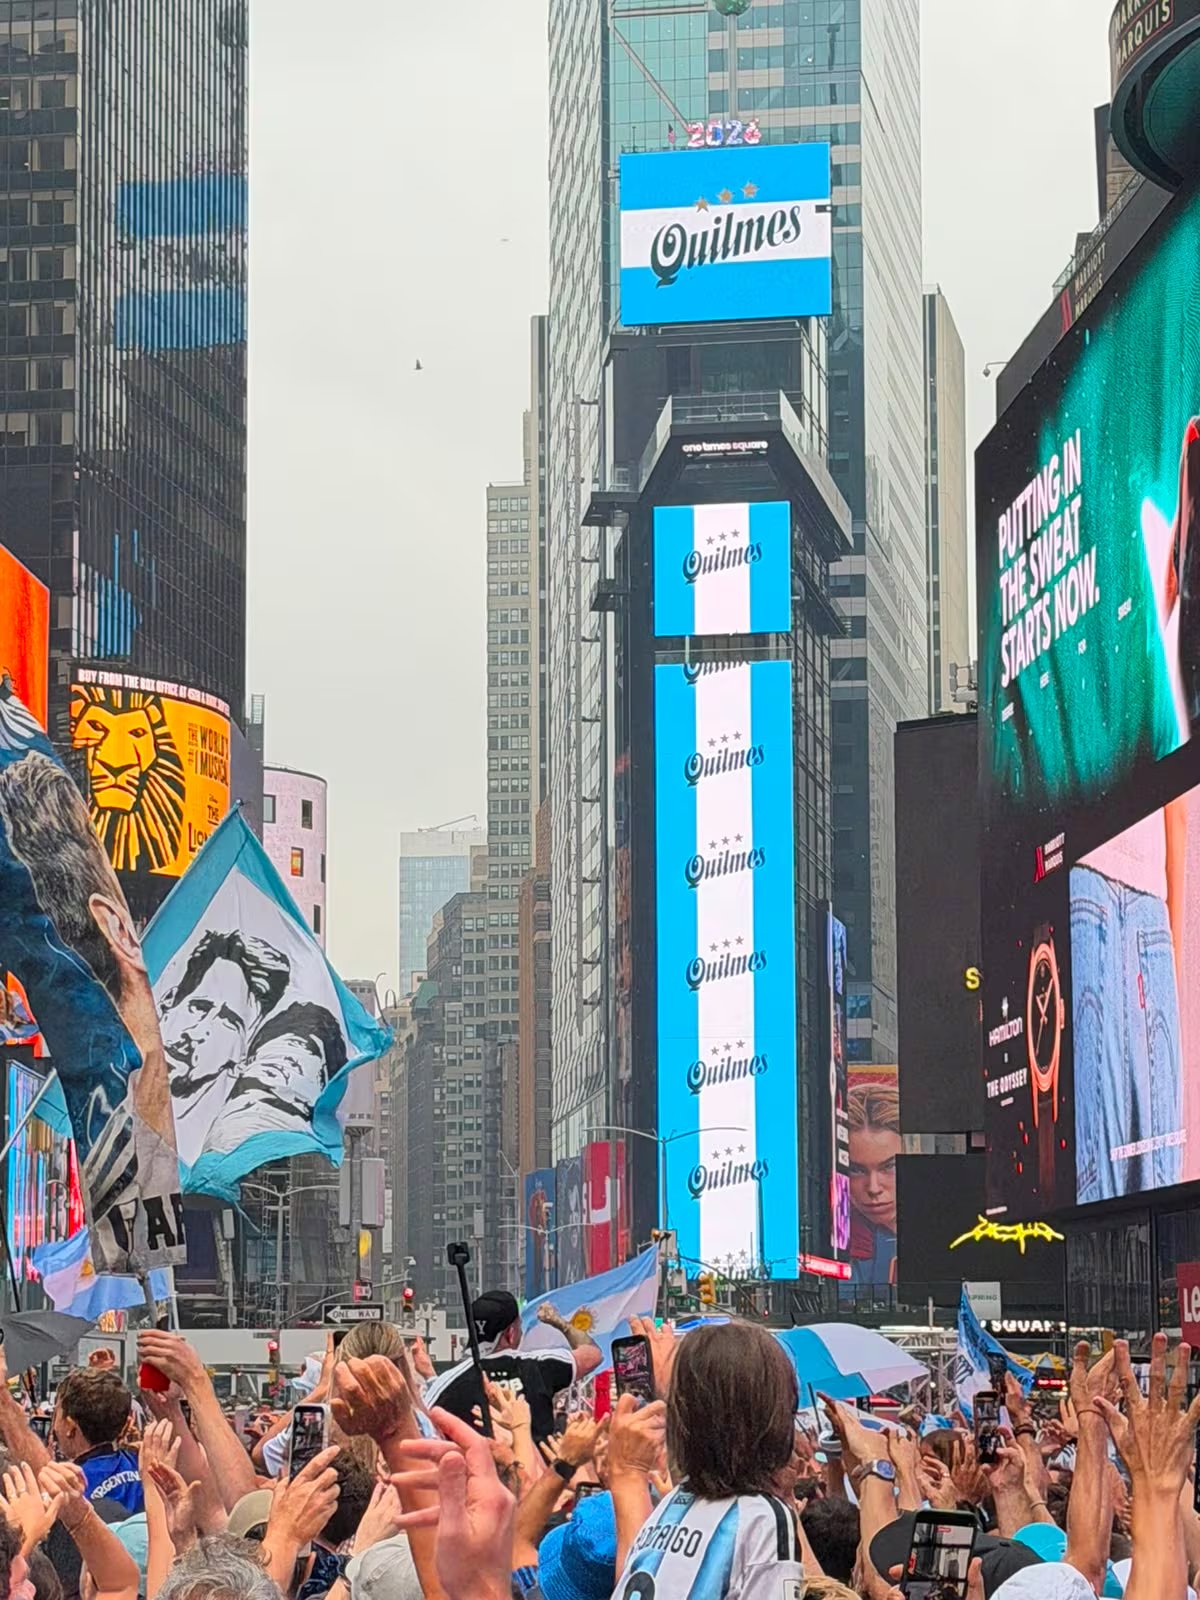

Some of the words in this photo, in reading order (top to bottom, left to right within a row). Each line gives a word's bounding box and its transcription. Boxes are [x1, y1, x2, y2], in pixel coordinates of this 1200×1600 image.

[687, 119, 762, 147] 2026
[651, 206, 802, 288] Quilmes
[999, 454, 1060, 569] PUTTING
[1063, 428, 1082, 499] IN
[682, 541, 763, 585] Quilmes
[1000, 553, 1027, 626] THE
[1030, 494, 1082, 598] SWEAT
[1001, 592, 1051, 688] STARTS
[1054, 544, 1100, 640] NOW.
[78, 669, 96, 683] BUY
[99, 671, 123, 686] FROM
[124, 674, 140, 689] THE
[684, 744, 765, 787] Quilmes
[684, 847, 766, 889] Quilmes
[685, 950, 767, 992] Quilmes
[686, 1053, 768, 1096] Quilmes
[987, 1079, 999, 1099] THE
[687, 1158, 769, 1200] Quilmes
[332, 1310, 349, 1319] ONE
[358, 1310, 377, 1318] WAY
